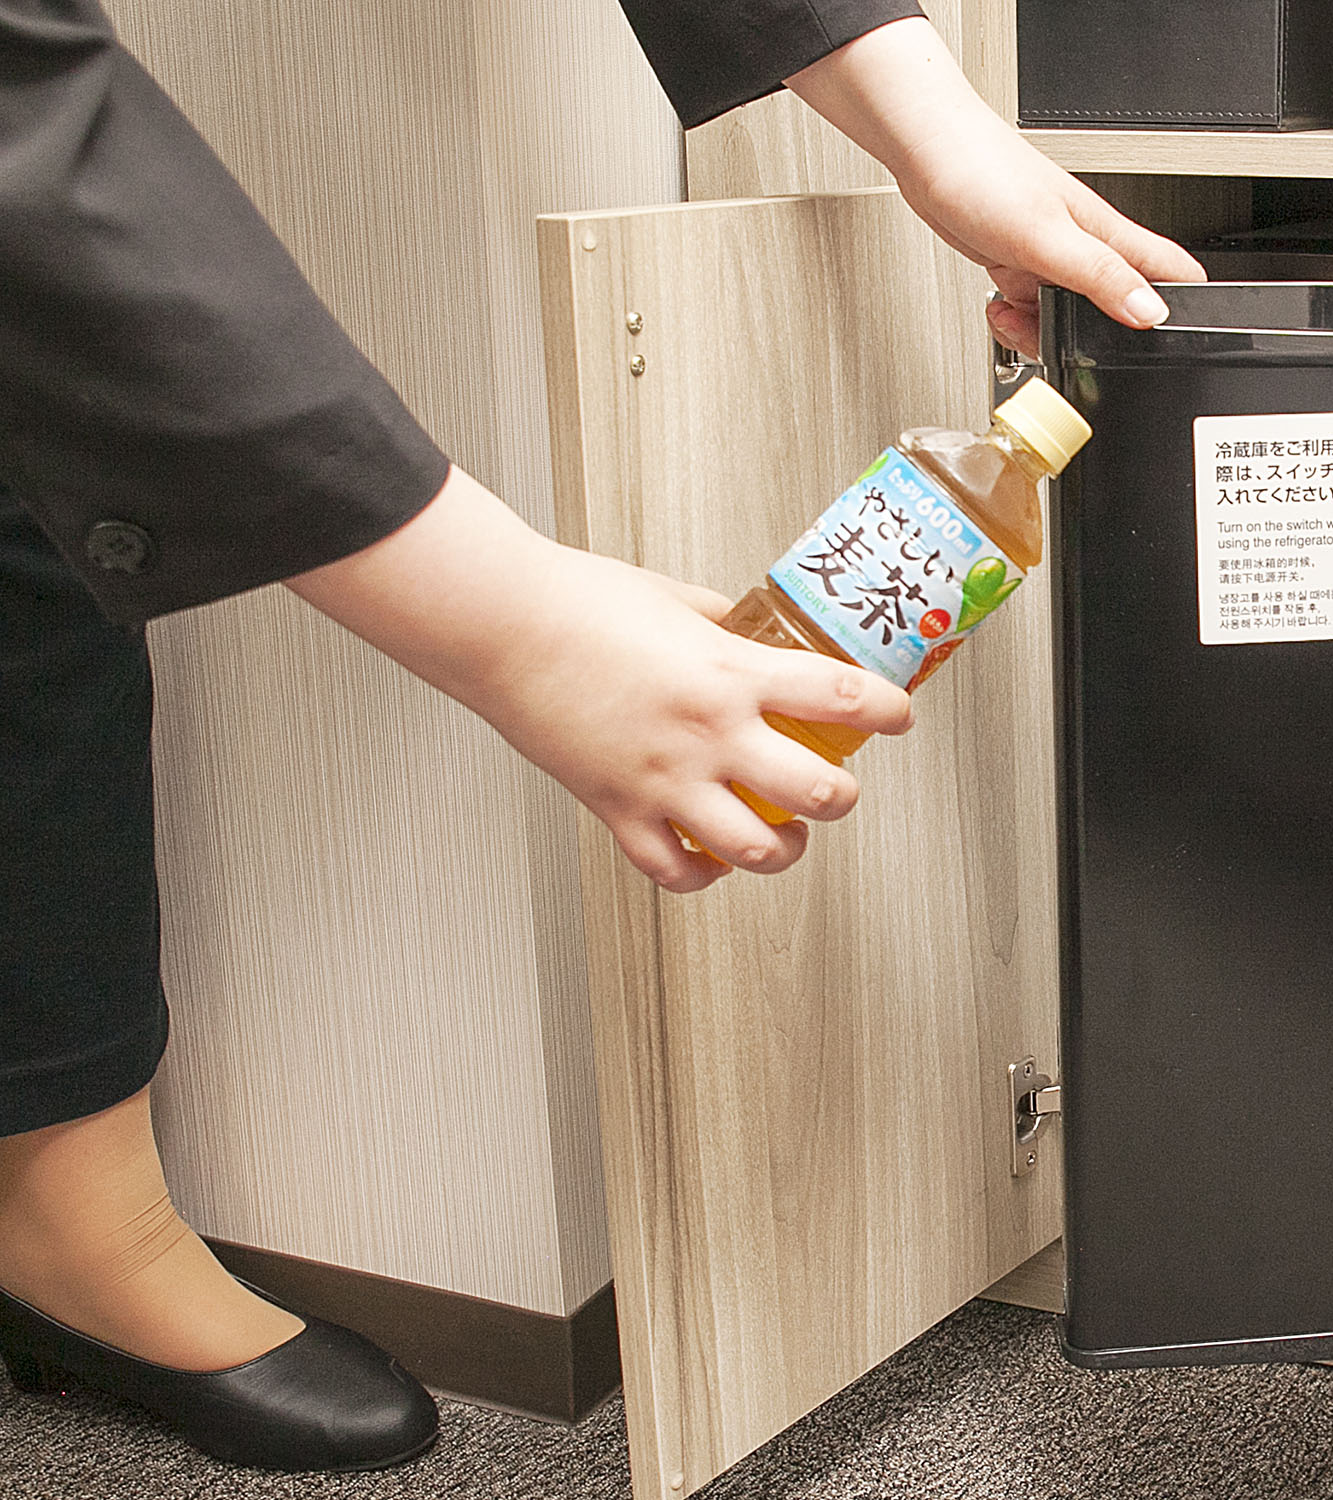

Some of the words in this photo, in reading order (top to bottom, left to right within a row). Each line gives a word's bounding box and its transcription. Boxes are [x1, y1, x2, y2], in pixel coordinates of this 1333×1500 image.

[1217, 522, 1242, 533] Turn
[1246, 523, 1261, 532] on
[1265, 520, 1283, 531] the
[1287, 519, 1322, 530] switch
[859, 486, 954, 583] やさしい
[1218, 538, 1249, 551] using
[1253, 537, 1271, 547] the
[796, 522, 929, 646] 麦茶
[1264, 592, 1283, 602] 사용
[1287, 590, 1307, 601] 하실
[1220, 619, 1250, 630] 사용해
[1254, 617, 1284, 628] 주시기
